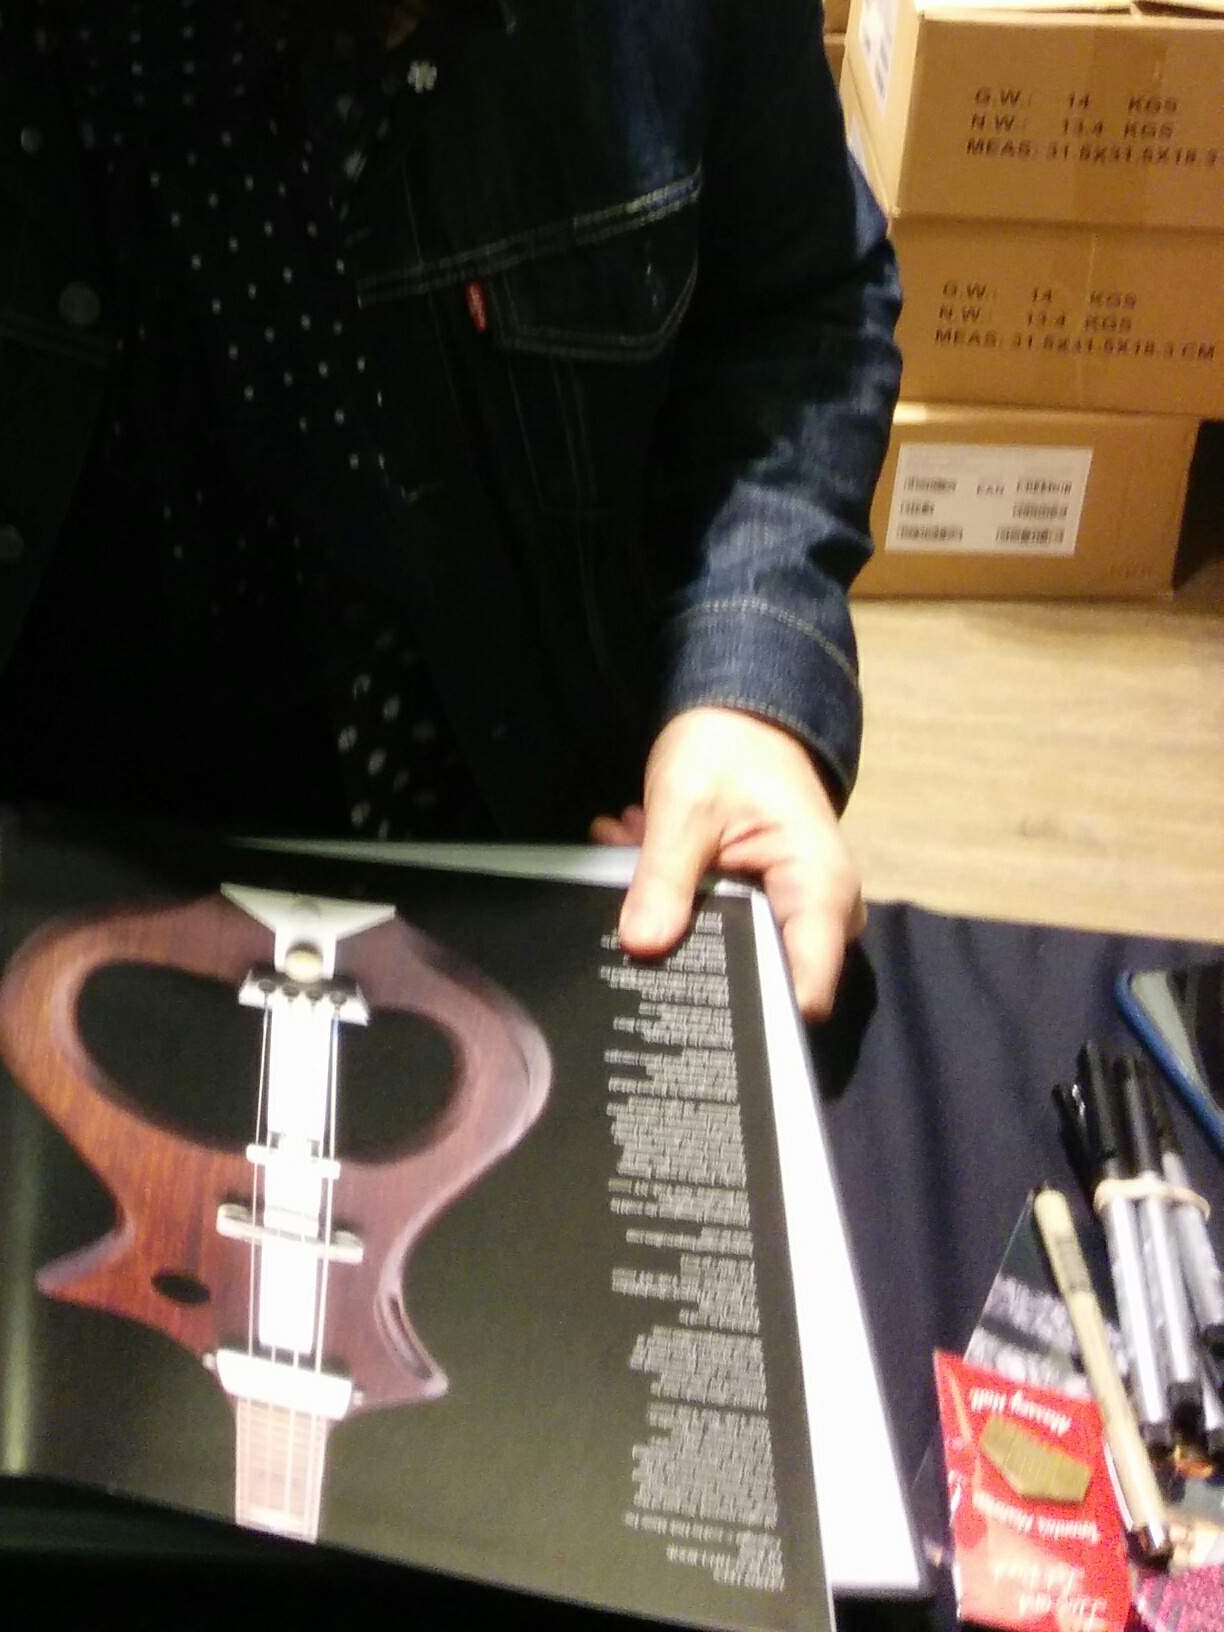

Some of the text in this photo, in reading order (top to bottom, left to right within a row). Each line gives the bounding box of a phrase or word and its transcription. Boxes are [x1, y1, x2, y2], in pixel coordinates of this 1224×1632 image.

[1069, 91, 1091, 110] 14
[1127, 95, 1178, 113] KGS
[1123, 121, 1174, 140] KGS
[1032, 287, 1053, 304] 14
[1088, 290, 1138, 310] KGS
[1084, 314, 1133, 333] KGS
[1181, 342, 1216, 361] CM
